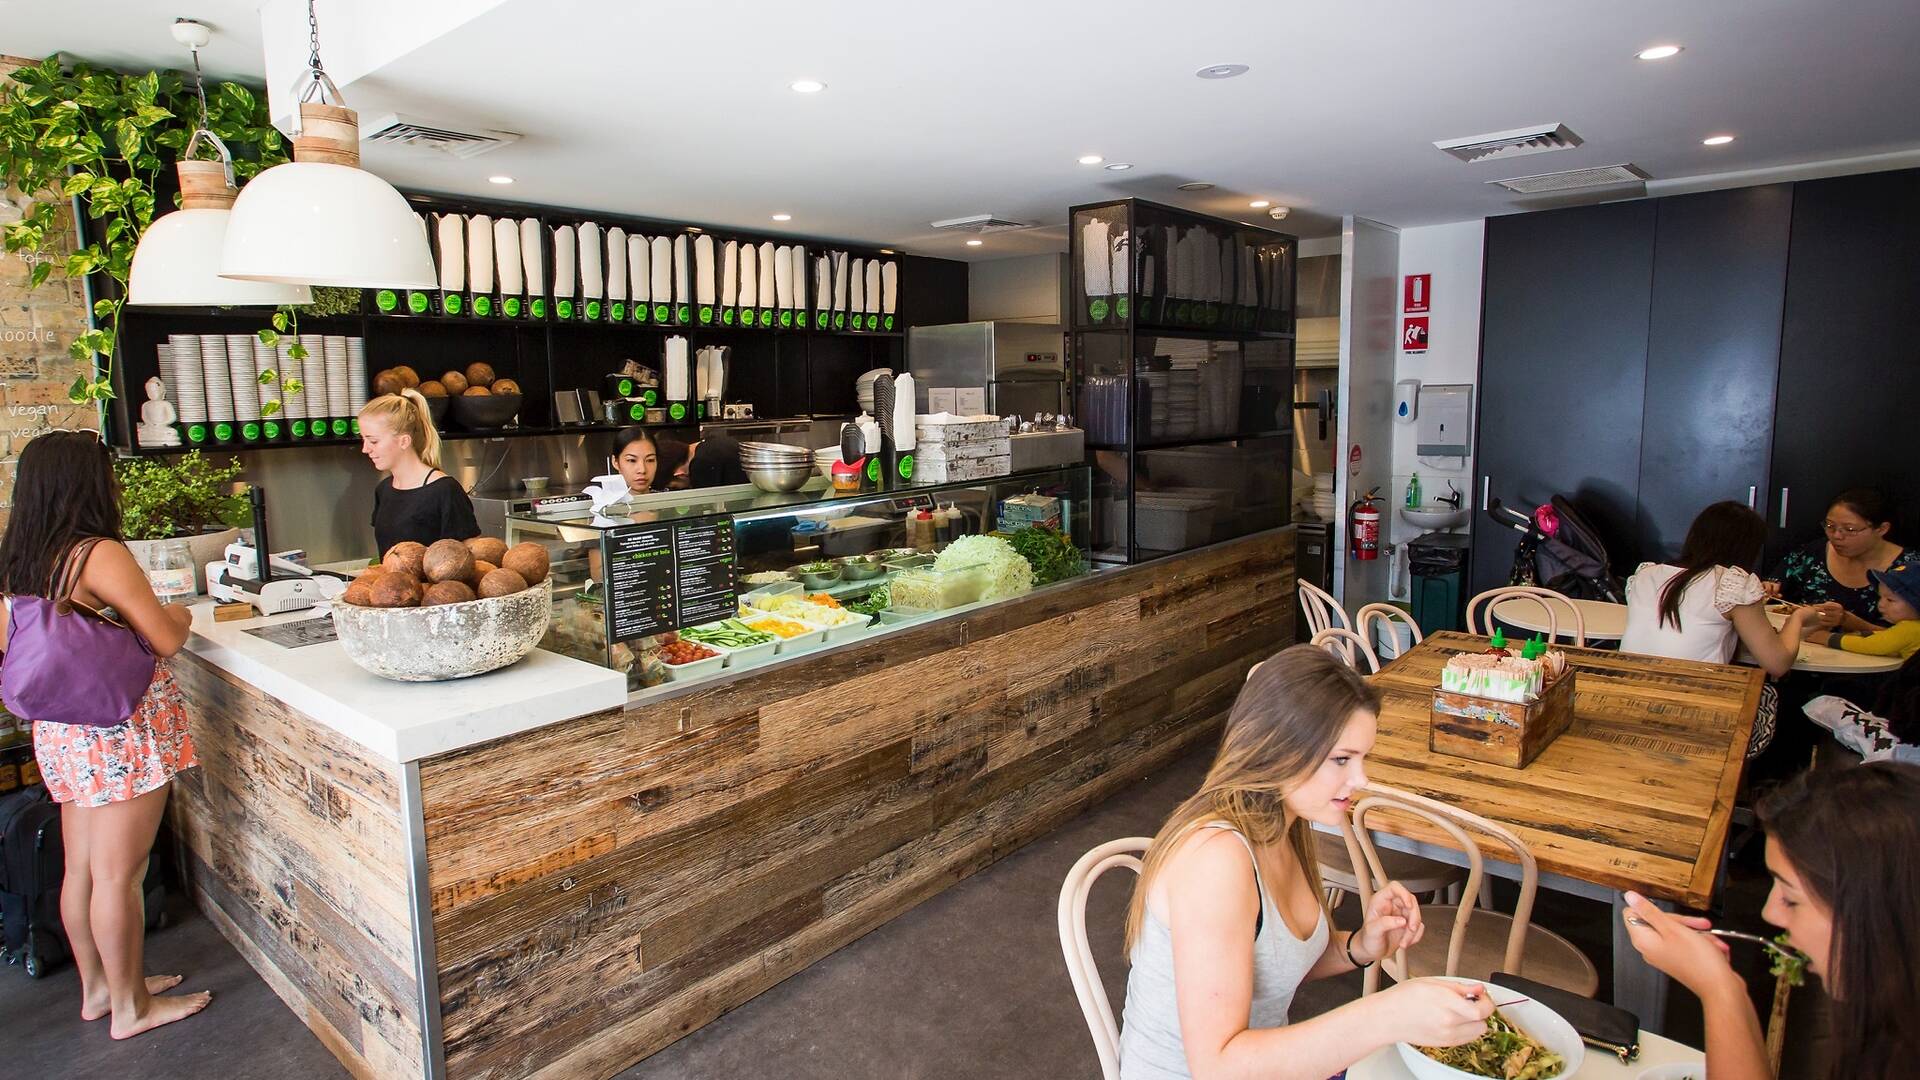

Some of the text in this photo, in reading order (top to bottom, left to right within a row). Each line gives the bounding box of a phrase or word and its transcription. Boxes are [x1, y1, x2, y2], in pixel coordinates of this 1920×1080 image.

[0, 327, 57, 342] oodle
[8, 405, 59, 422] vegan
[10, 426, 54, 439] vega
